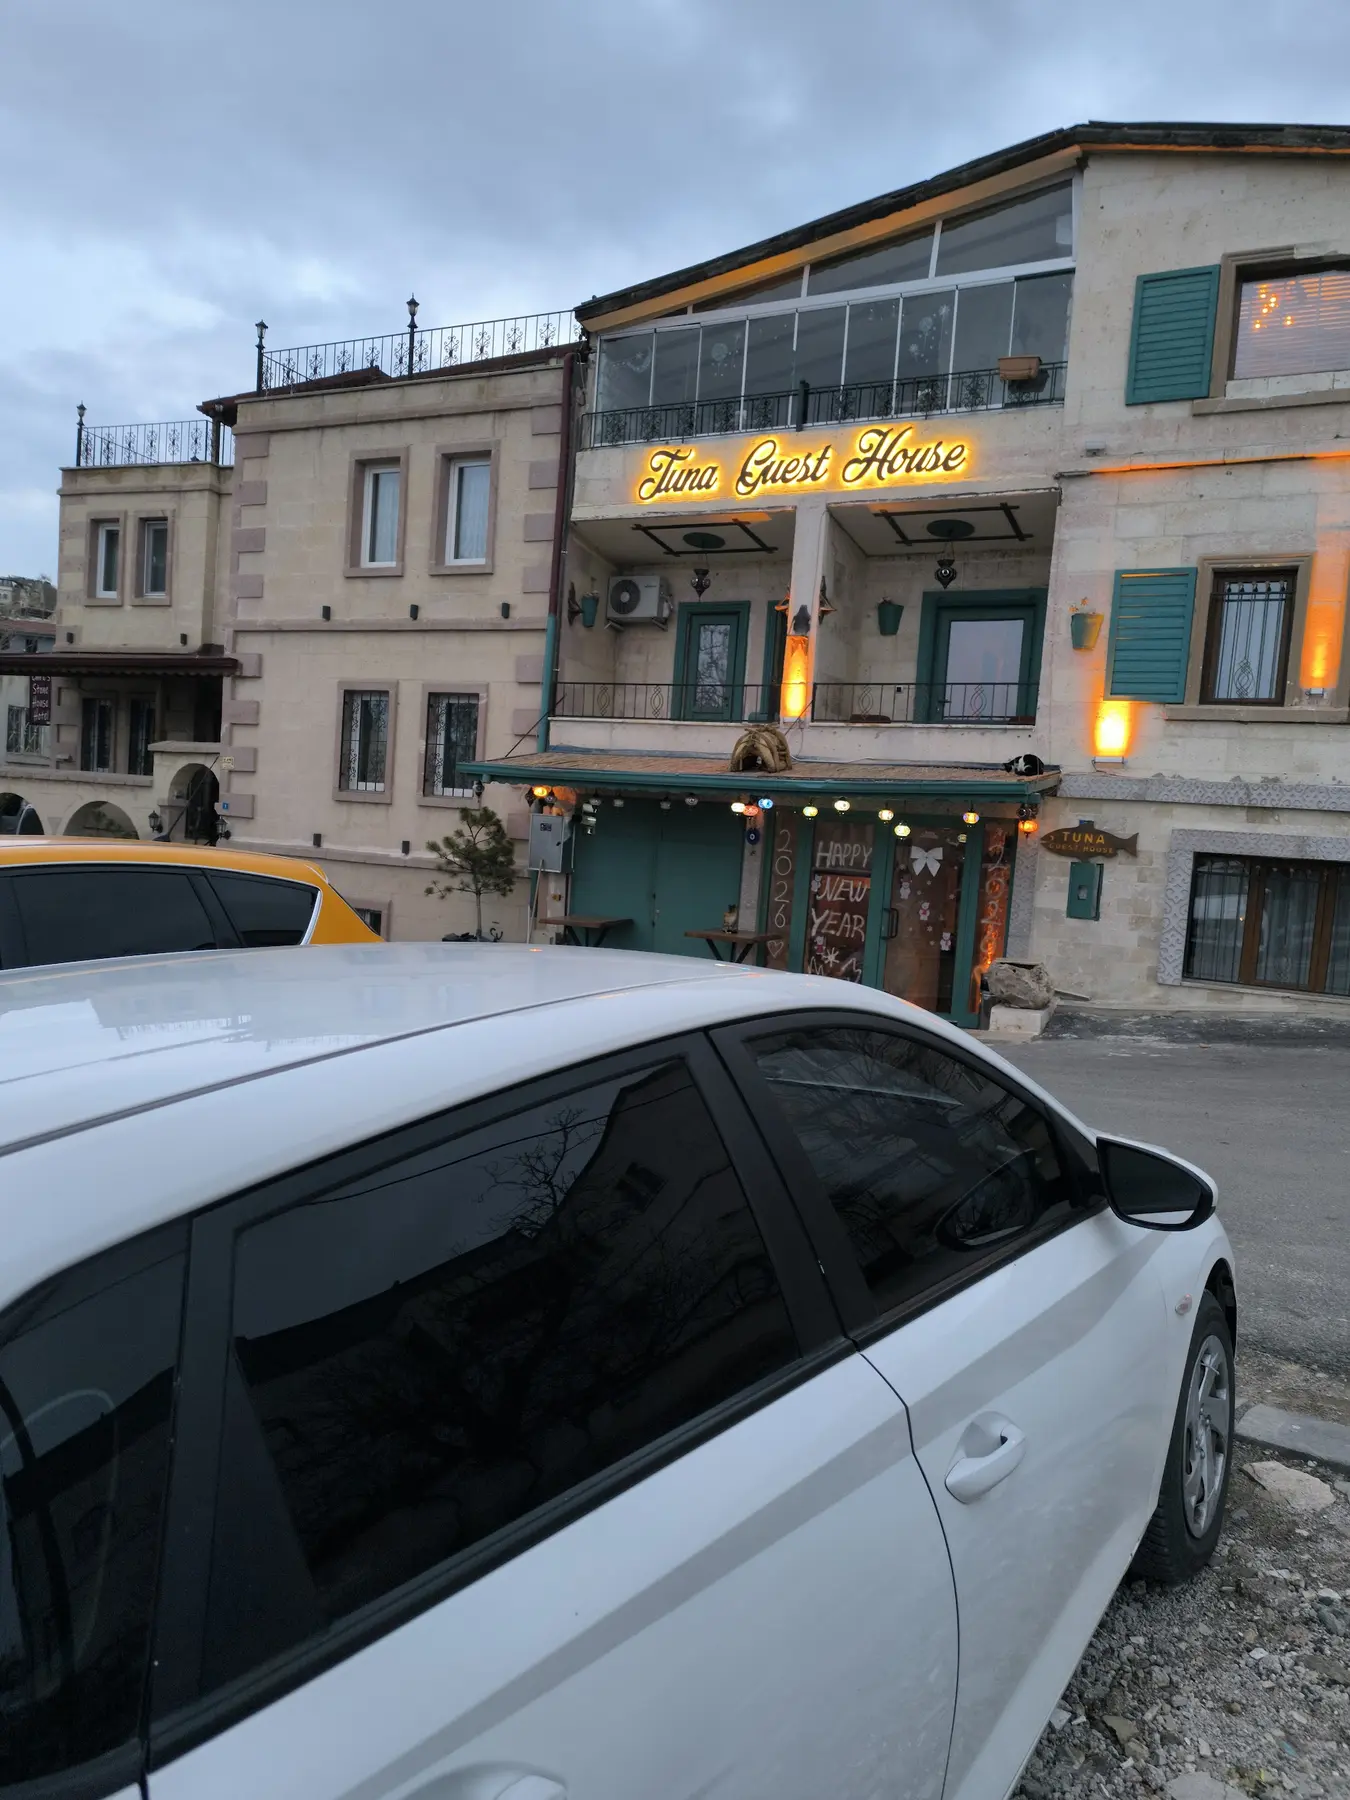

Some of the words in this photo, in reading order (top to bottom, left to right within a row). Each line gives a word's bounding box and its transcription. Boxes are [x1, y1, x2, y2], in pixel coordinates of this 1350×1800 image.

[638, 448, 719, 501] Tuna
[735, 439, 832, 496] Guest
[842, 426, 966, 484] House
[1061, 831, 1105, 844] TUNA
[1083, 846, 1114, 854] HOUSE
[815, 840, 872, 868] HAPPY
[774, 829, 792, 928] 2026
[816, 876, 867, 902] NEW
[811, 907, 865, 942] YEAR
